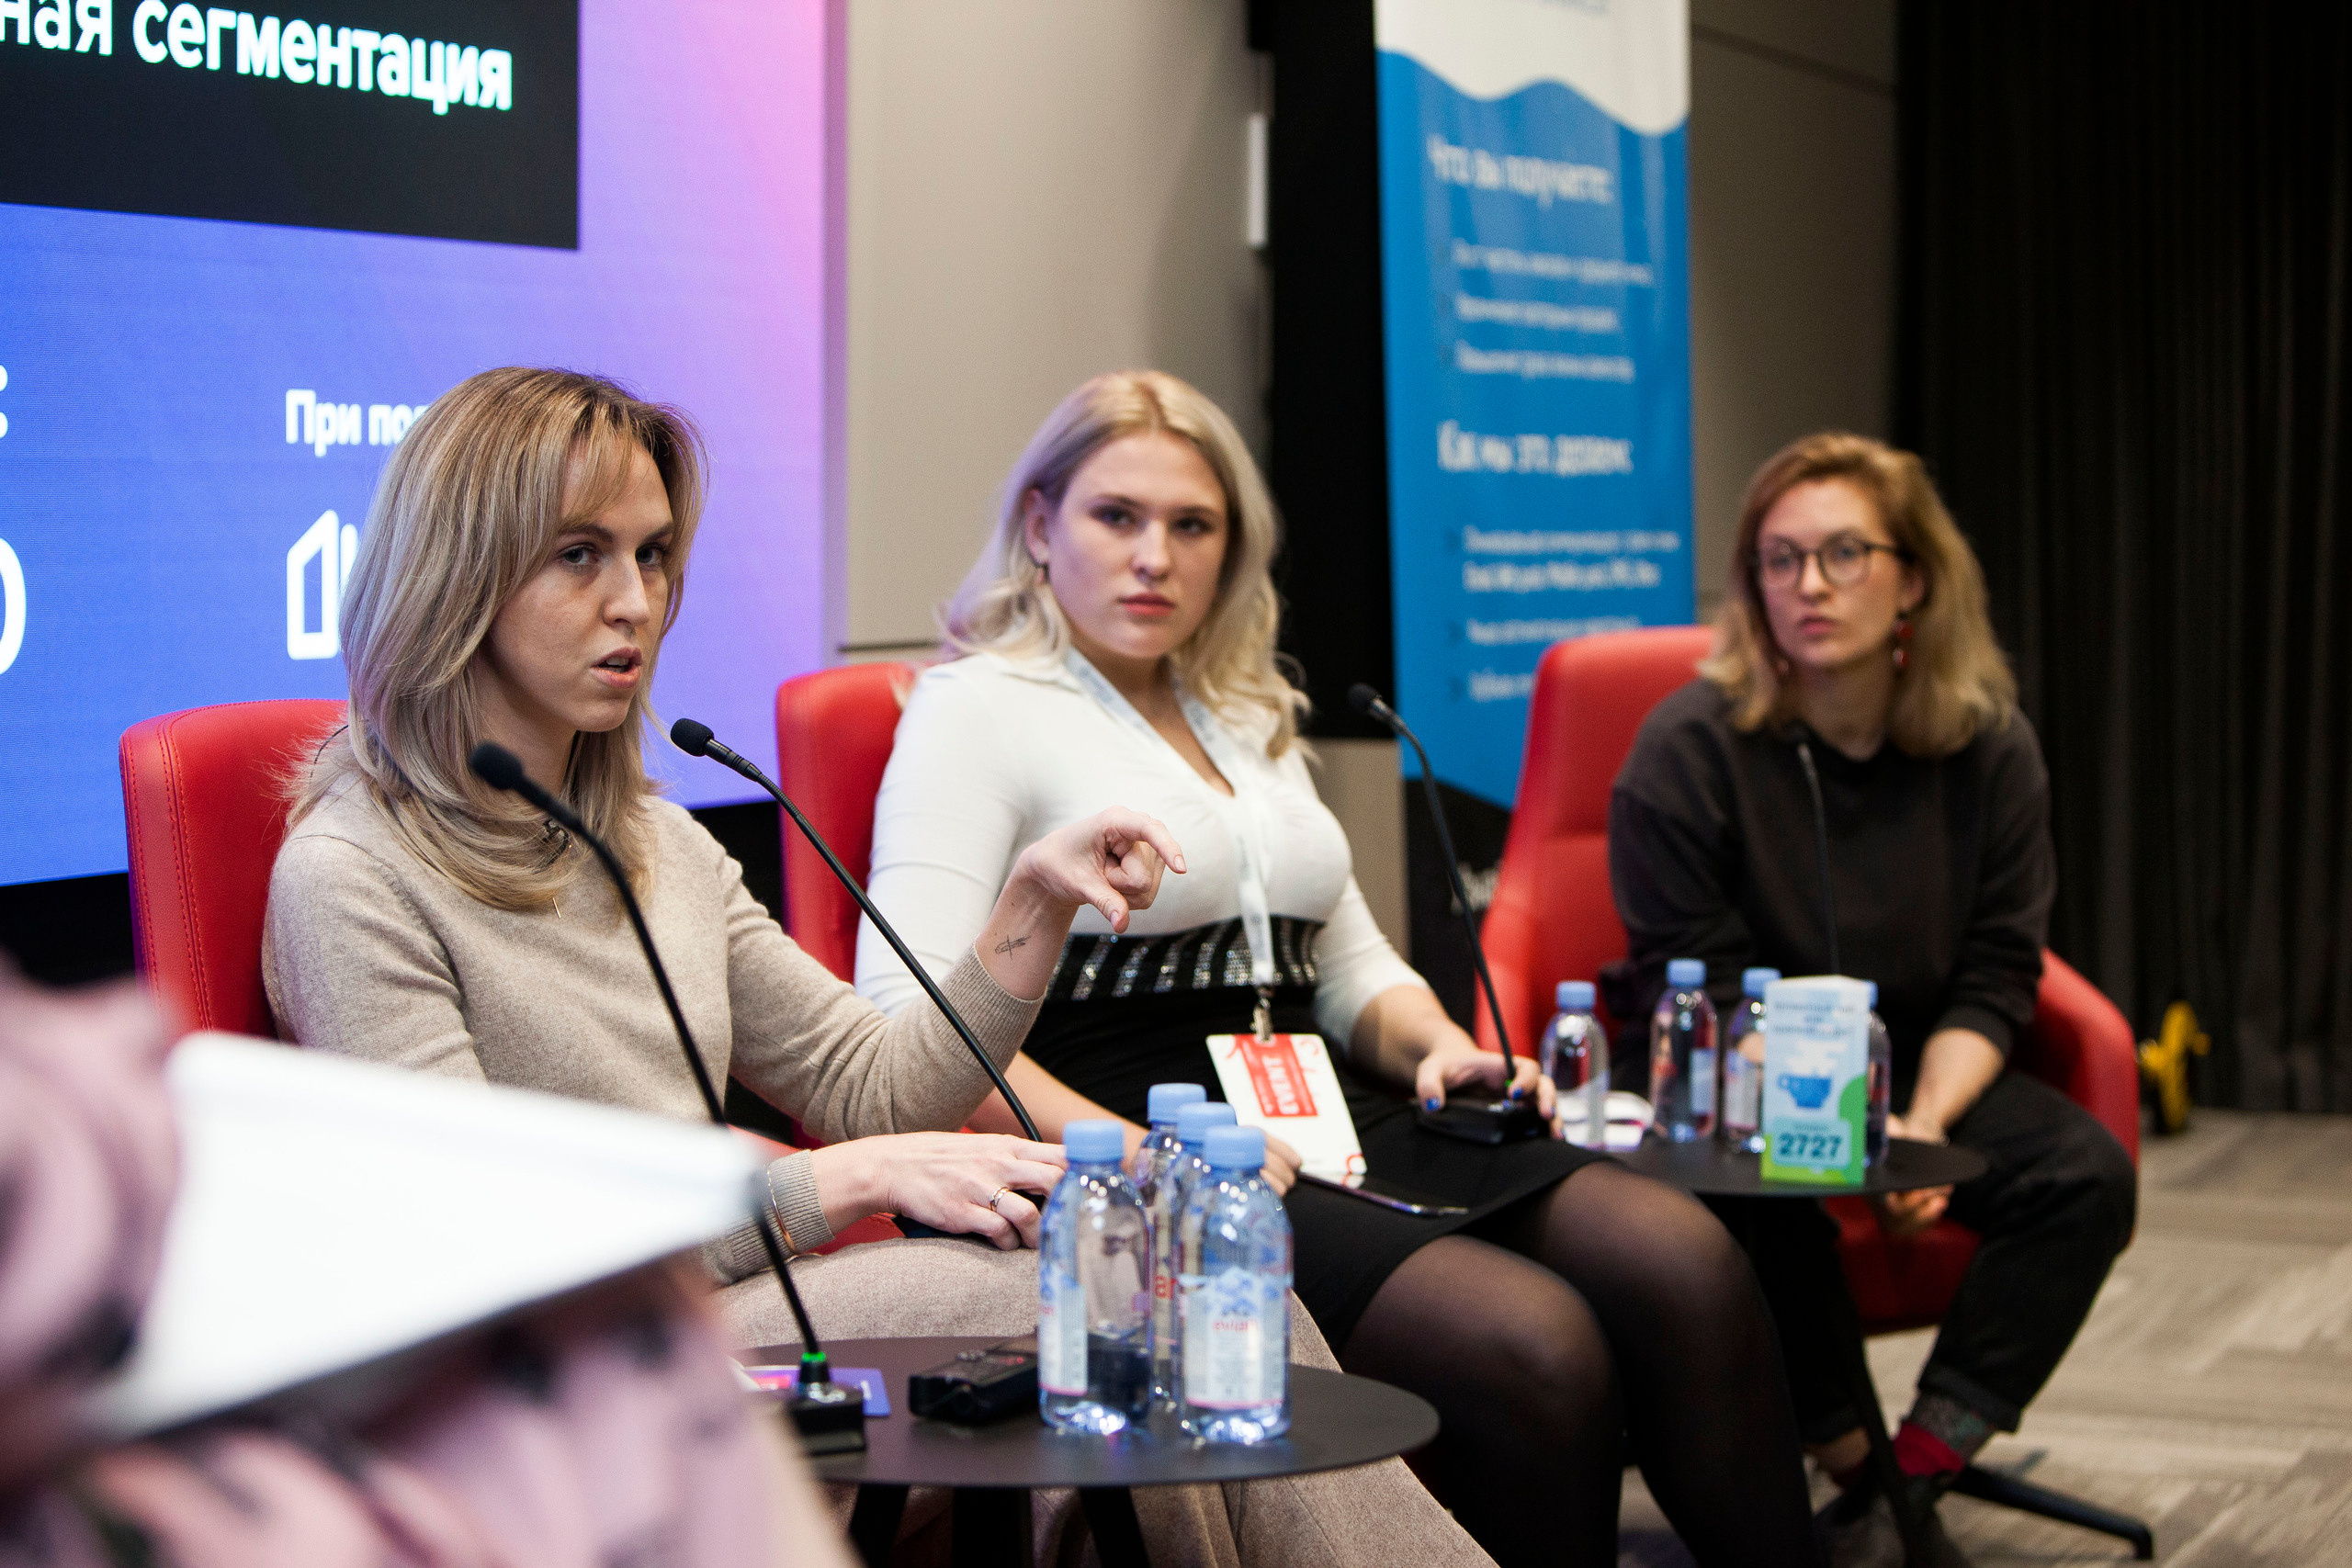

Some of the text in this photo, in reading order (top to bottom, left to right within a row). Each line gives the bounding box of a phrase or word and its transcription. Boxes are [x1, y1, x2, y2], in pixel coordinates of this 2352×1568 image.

[132, 0, 514, 116] сегментация
[285, 389, 430, 457] При по
[1778, 1133, 1842, 1159] 2727
